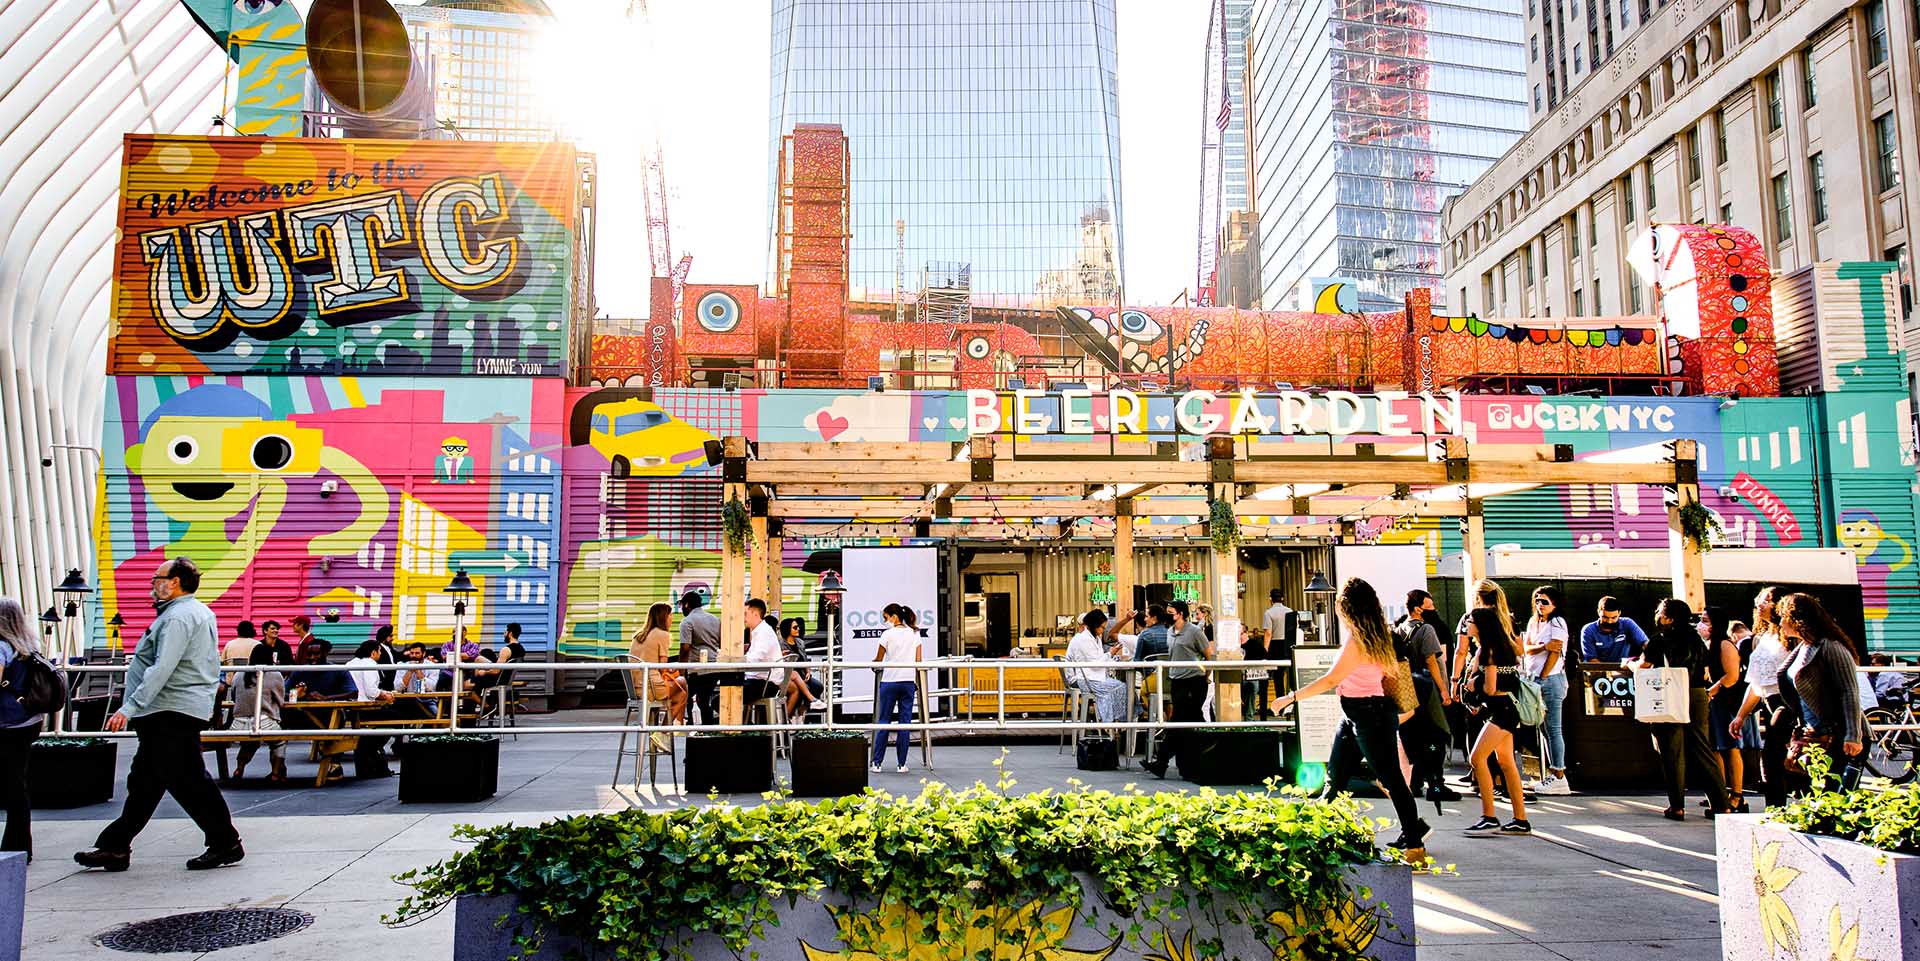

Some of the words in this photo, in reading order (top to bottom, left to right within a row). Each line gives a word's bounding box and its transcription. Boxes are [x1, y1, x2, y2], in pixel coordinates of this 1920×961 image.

[137, 177, 319, 219] Welcome
[326, 168, 364, 192] to
[370, 159, 426, 185] the
[140, 172, 522, 342] WTC
[476, 357, 517, 375] LYNNE
[519, 363, 542, 375] YUN
[967, 389, 1142, 435] BEER
[1174, 388, 1464, 436] GARDEN
[1511, 402, 1675, 432] JCBKNYC
[1739, 477, 1796, 540] TUNNEL
[1609, 699, 1633, 707] BEER
